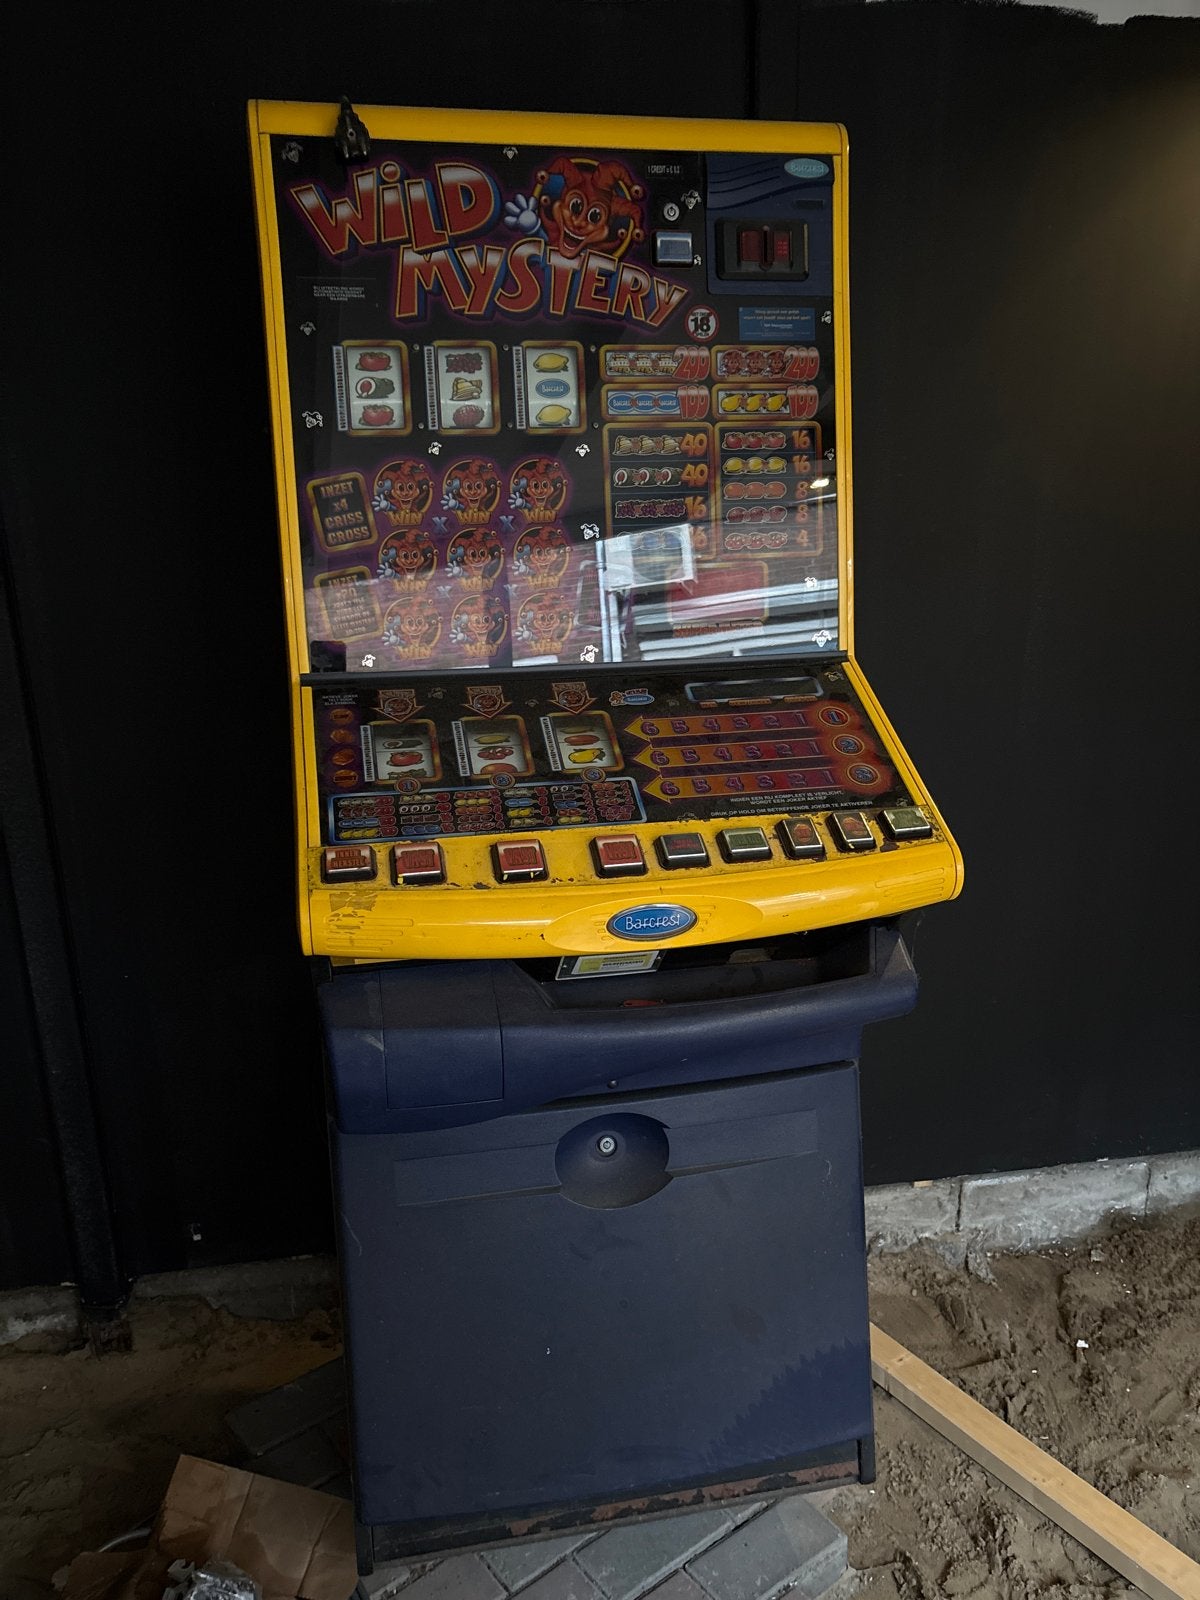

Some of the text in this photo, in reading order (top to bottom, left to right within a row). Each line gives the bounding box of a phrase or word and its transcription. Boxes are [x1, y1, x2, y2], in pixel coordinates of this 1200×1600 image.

[396, 237, 688, 327] MYSTERY
[691, 316, 711, 332] 18
[672, 347, 710, 380] 200
[783, 347, 820, 380] 200
[677, 385, 710, 419] 100
[786, 385, 819, 419] 100
[680, 433, 708, 457] 40
[791, 430, 810, 448] 16
[681, 463, 709, 487] 40
[792, 455, 811, 473] 16
[320, 481, 354, 497] INZET
[685, 496, 707, 519] 16
[325, 511, 364, 529] CRISS
[328, 526, 370, 545] CROSS
[797, 529, 809, 546] 4
[641, 722, 659, 736] 6
[671, 720, 689, 734] 5
[704, 718, 720, 731] 4
[733, 716, 749, 729] 3
[763, 715, 780, 727] 2
[651, 751, 669, 765] 6
[681, 749, 700, 763] 5
[714, 747, 732, 761] 4
[745, 745, 762, 759] 3
[776, 743, 793, 755] 2
[661, 781, 680, 796] 6
[693, 778, 711, 793] 5
[726, 777, 744, 791] 4
[757, 775, 775, 789] 3
[788, 773, 806, 786] 2
[624, 913, 681, 931] Barcrest
